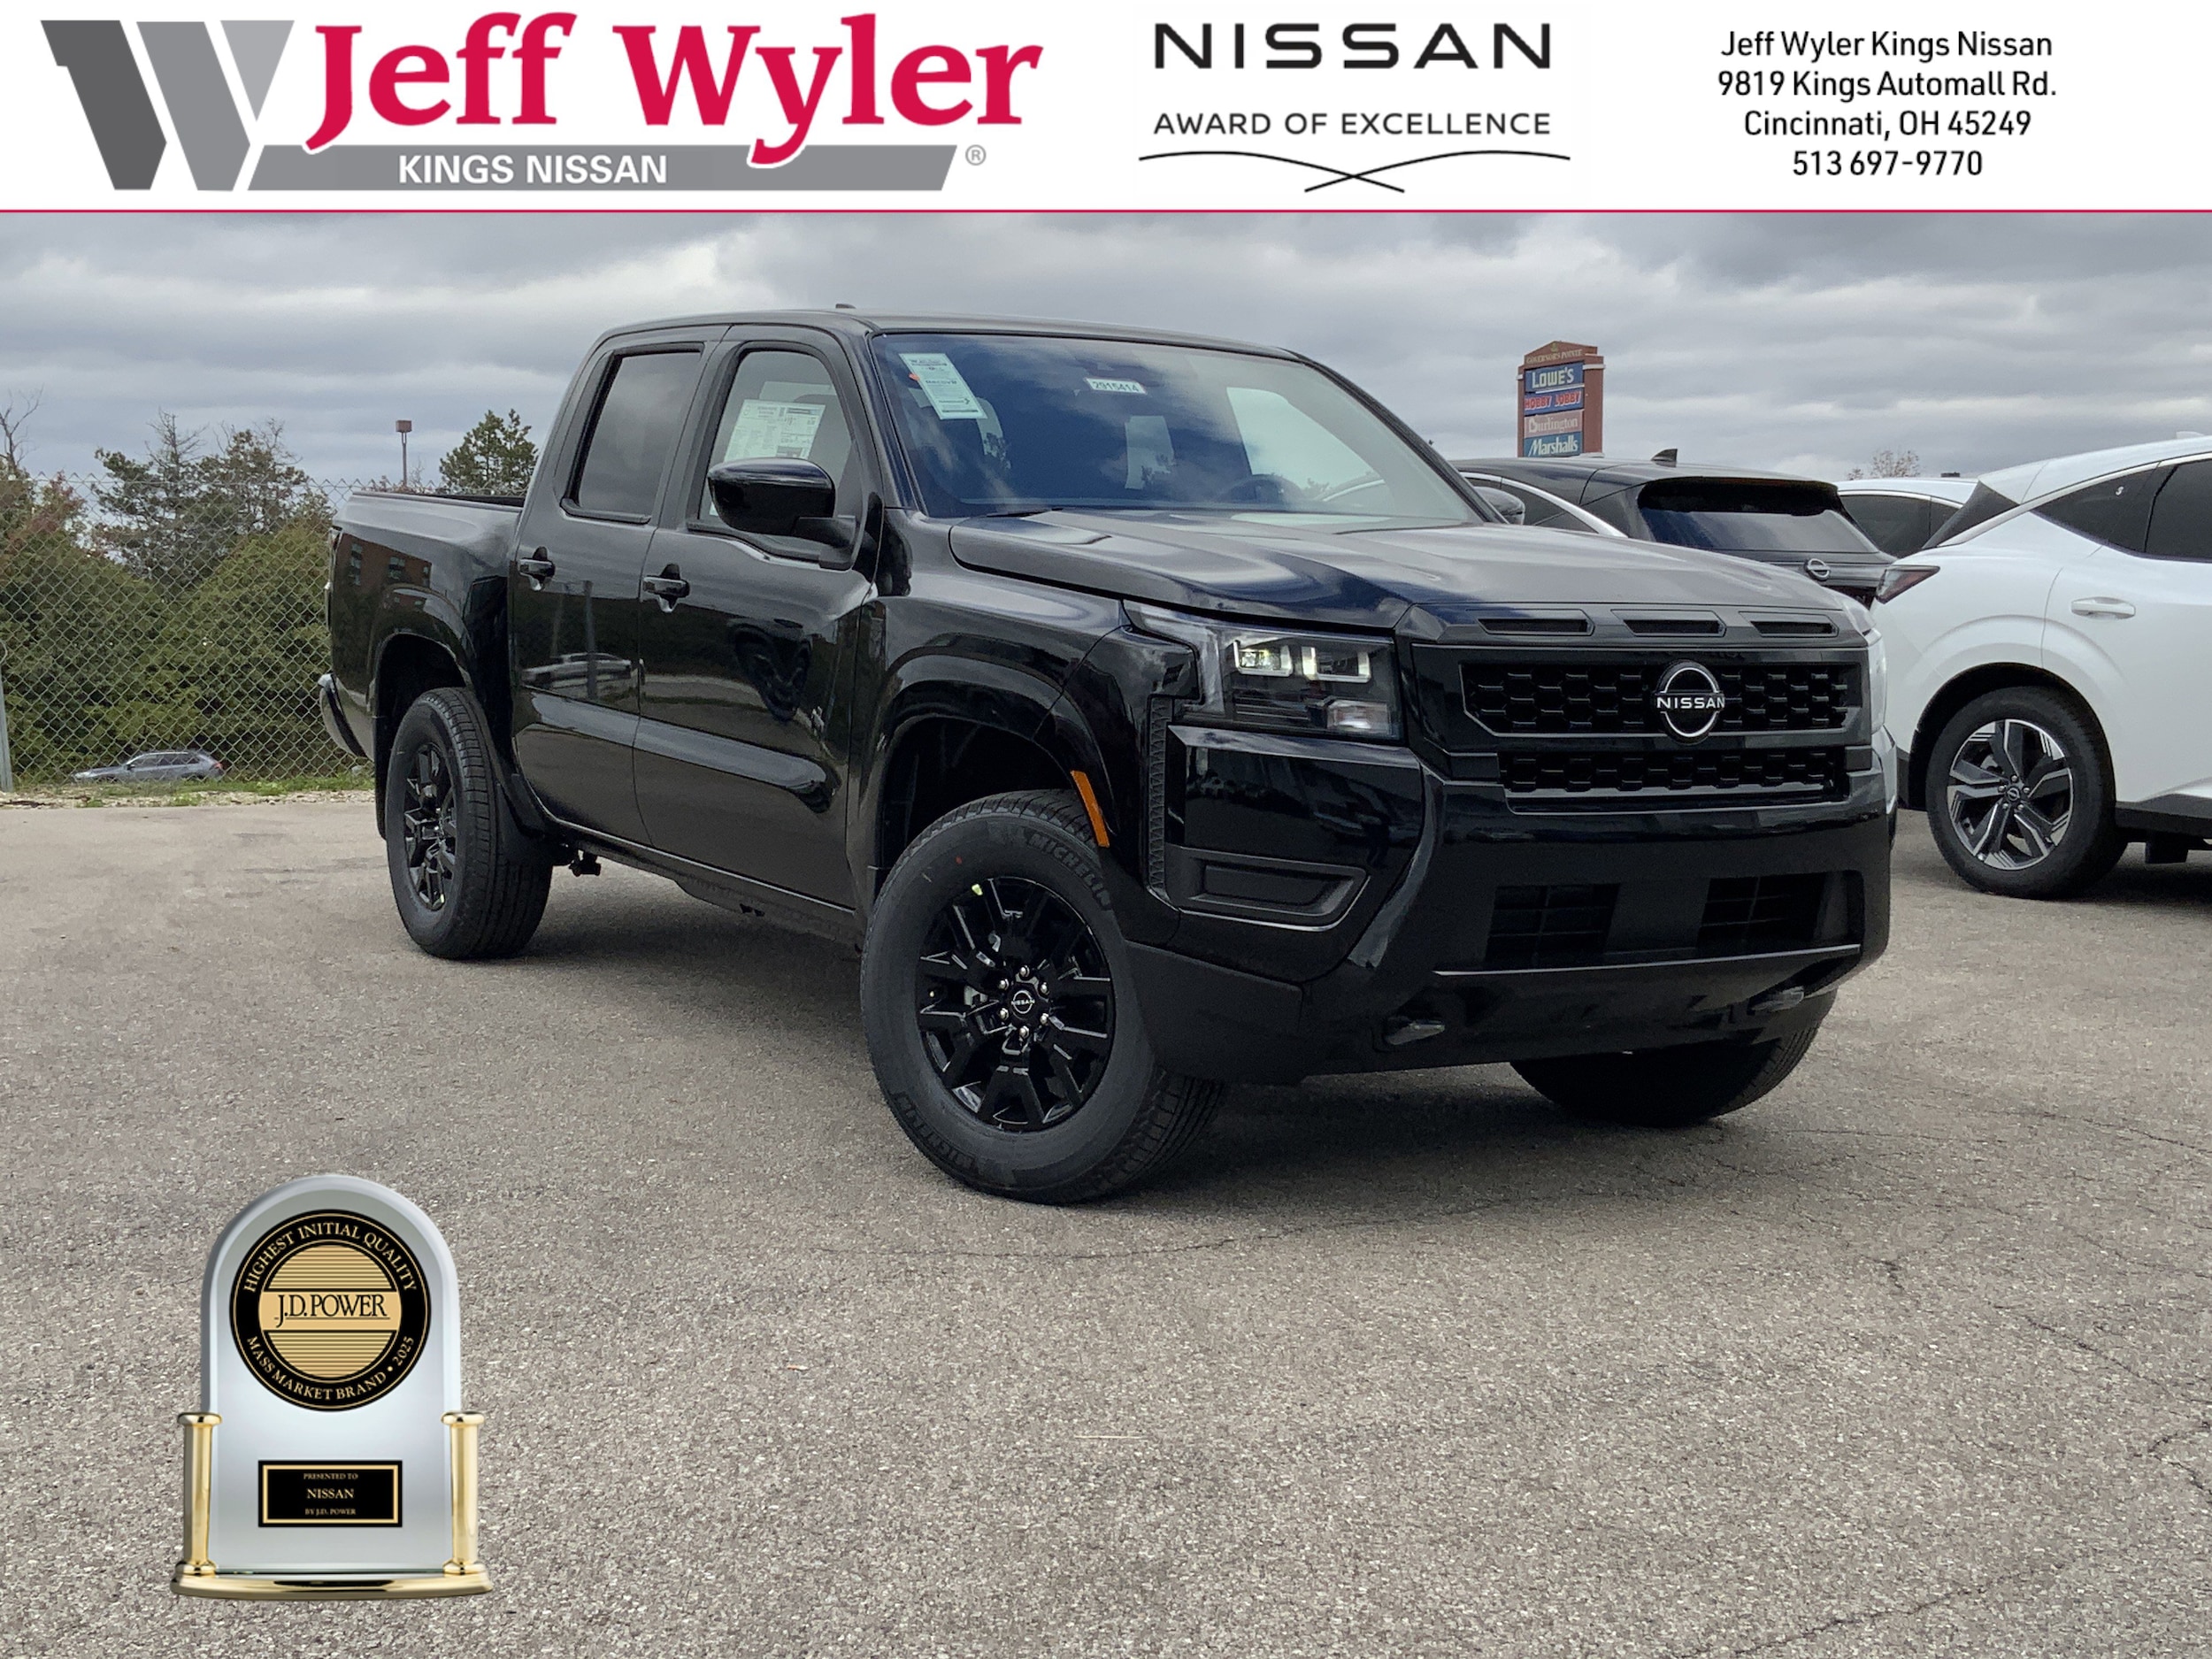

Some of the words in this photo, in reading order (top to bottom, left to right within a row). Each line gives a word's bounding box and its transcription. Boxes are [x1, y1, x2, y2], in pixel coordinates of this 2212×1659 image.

[1092, 380, 1139, 392] 2915414
[1532, 366, 1574, 388] LOWE'S
[1525, 396, 1552, 411] HOBBY
[1555, 391, 1581, 407] LOBBY
[1528, 434, 1578, 457] Marshalls
[1656, 696, 1725, 710] NISSAN
[1028, 833, 1111, 909] MICHELIN
